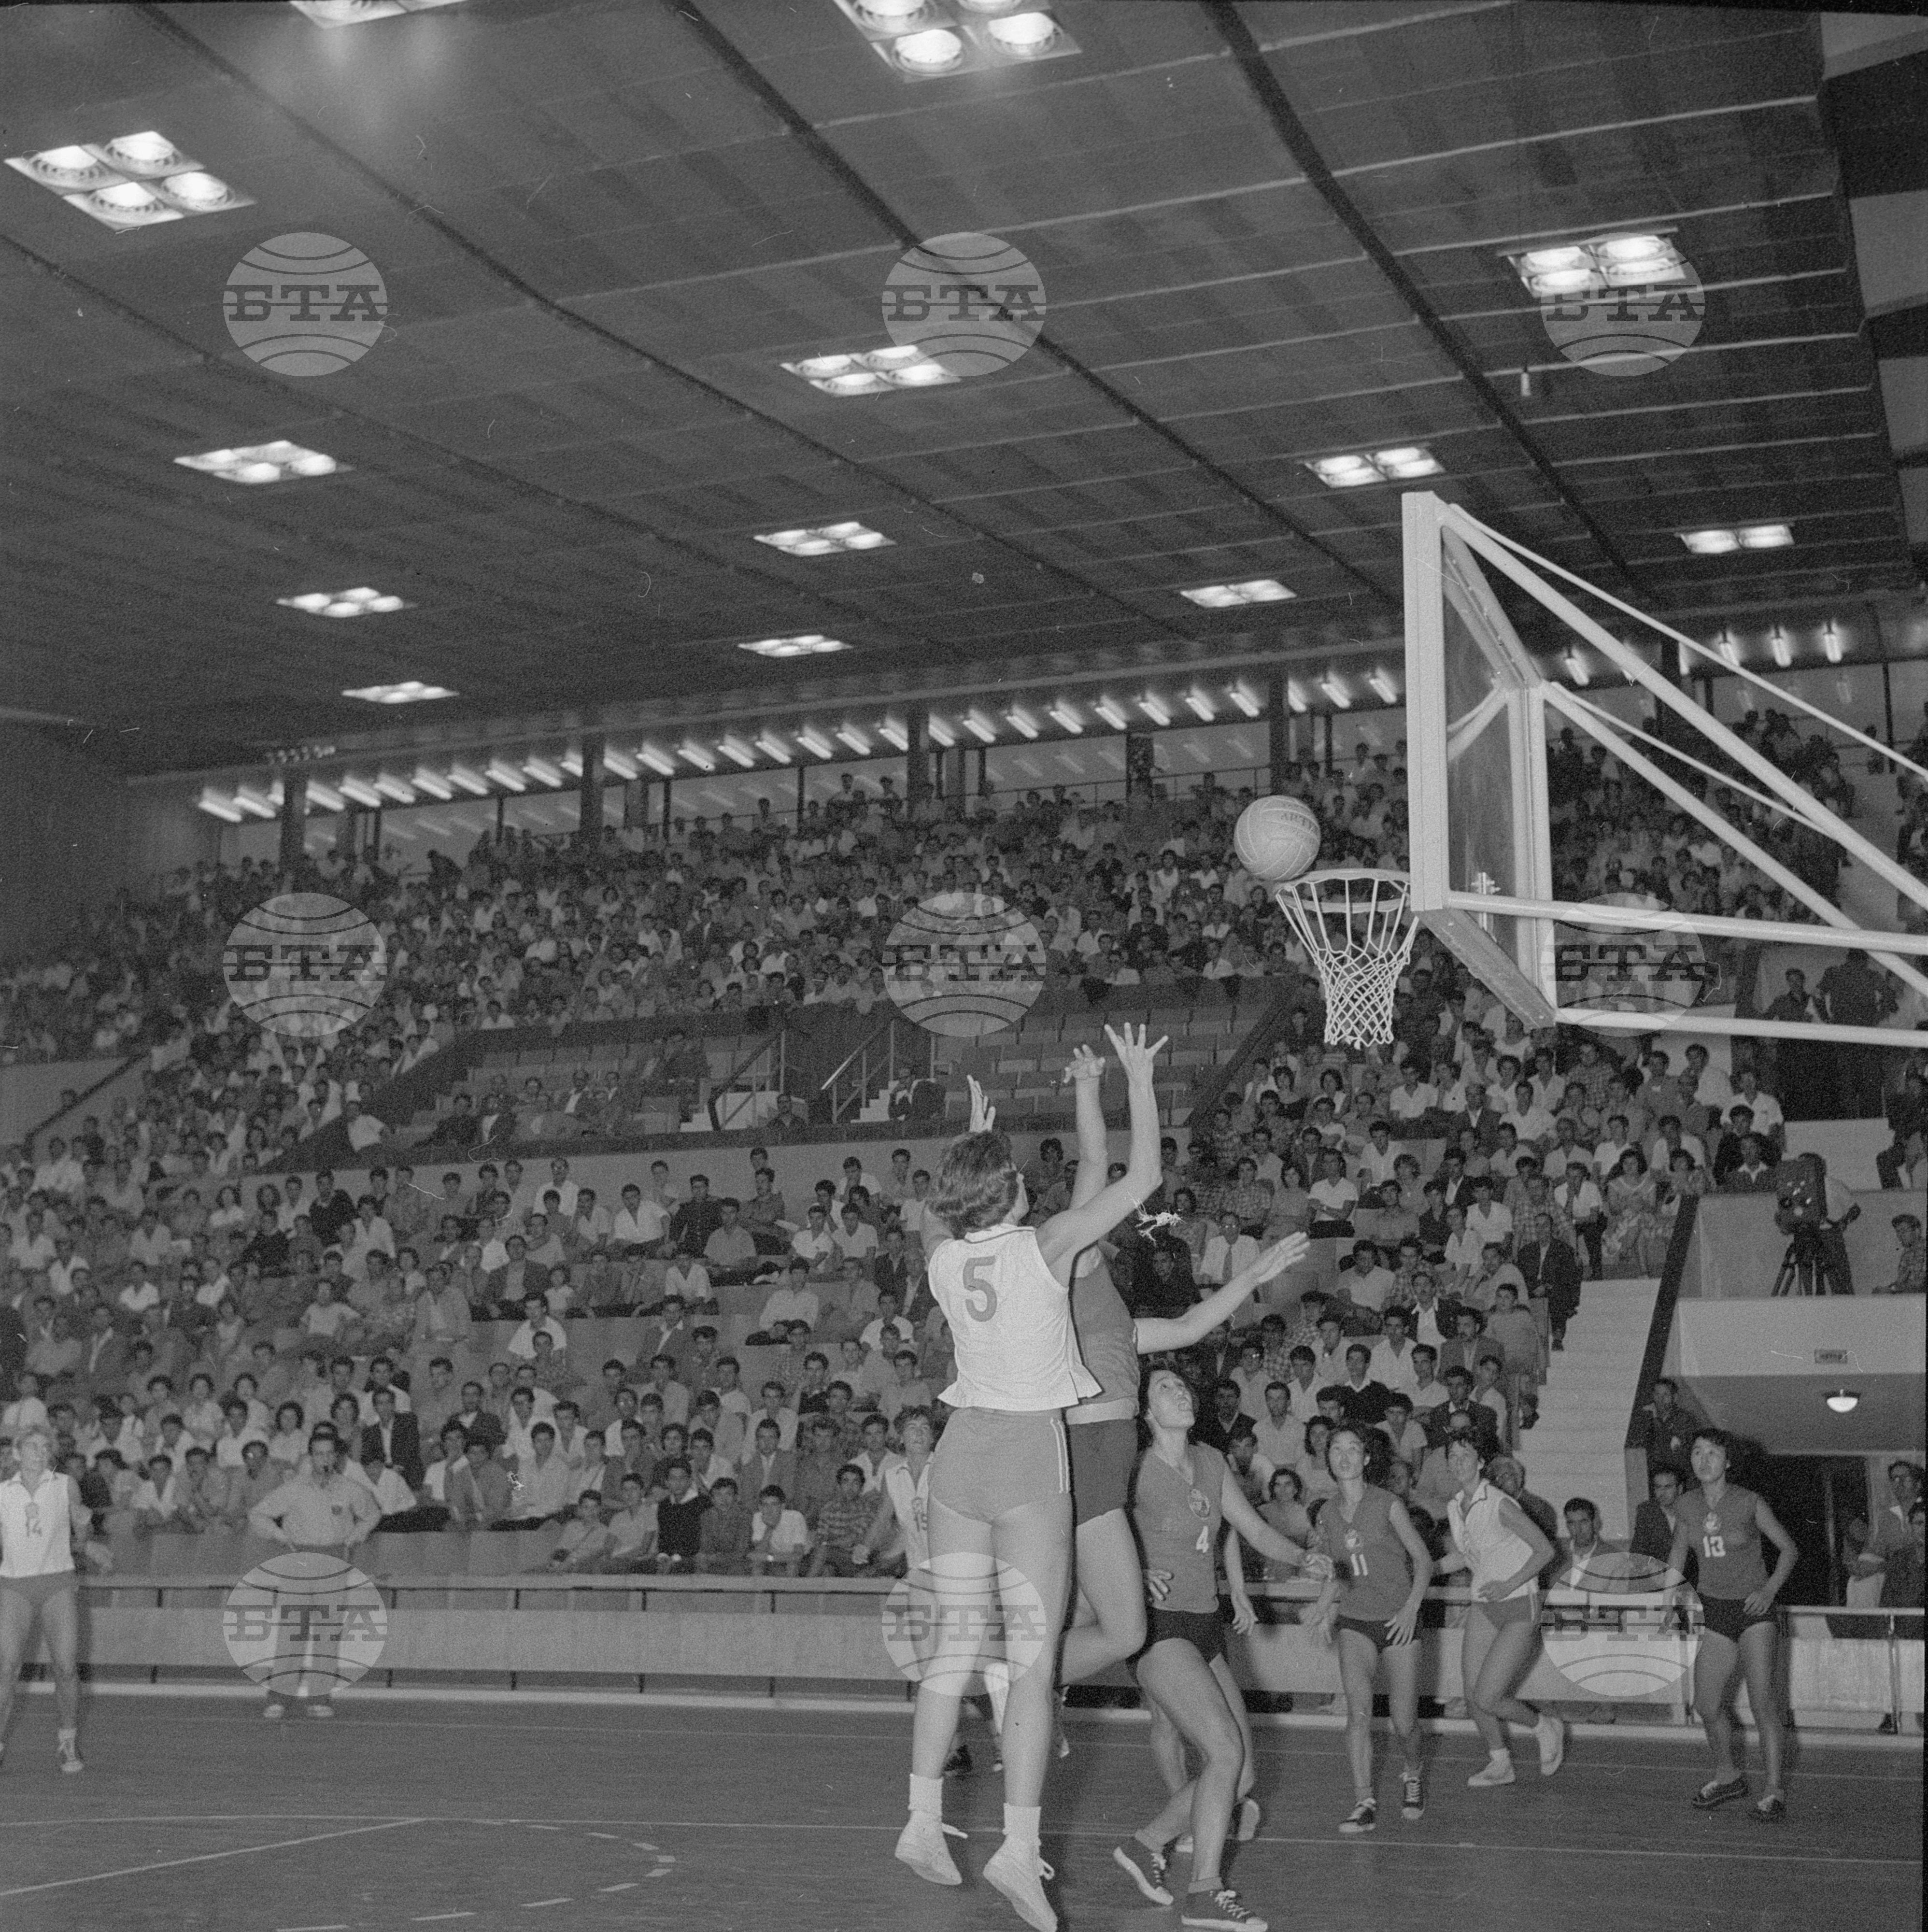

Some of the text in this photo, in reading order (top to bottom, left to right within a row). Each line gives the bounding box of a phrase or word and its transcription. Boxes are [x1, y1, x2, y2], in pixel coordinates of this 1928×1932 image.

[963, 1256, 997, 1322] 5
[1195, 1525, 1209, 1553] 4
[1702, 1536, 1726, 1558] 13
[1351, 1554, 1368, 1576] 11
